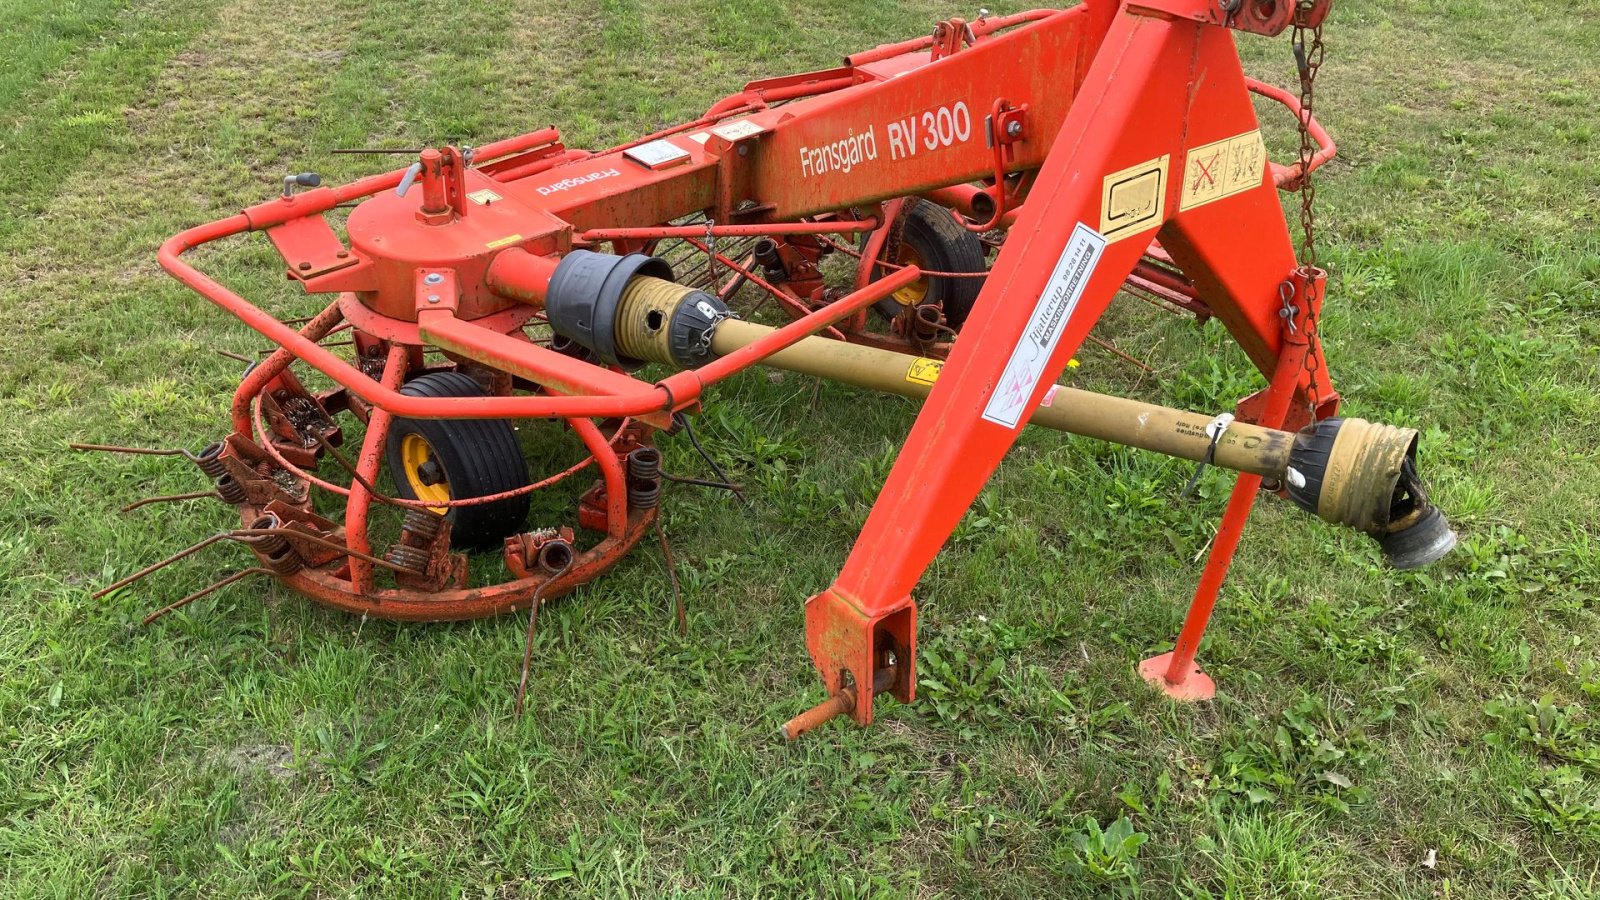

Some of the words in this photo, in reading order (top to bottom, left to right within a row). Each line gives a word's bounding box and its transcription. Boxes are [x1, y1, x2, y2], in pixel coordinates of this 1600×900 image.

[800, 124, 878, 178] Fransgård
[887, 115, 917, 161] RV
[922, 101, 971, 151] 300
[536, 168, 621, 196] Fransgård
[1074, 247, 1082, 258] 14
[1079, 238, 1086, 247] 11
[1043, 250, 1092, 341] MASKINFORRETNING
